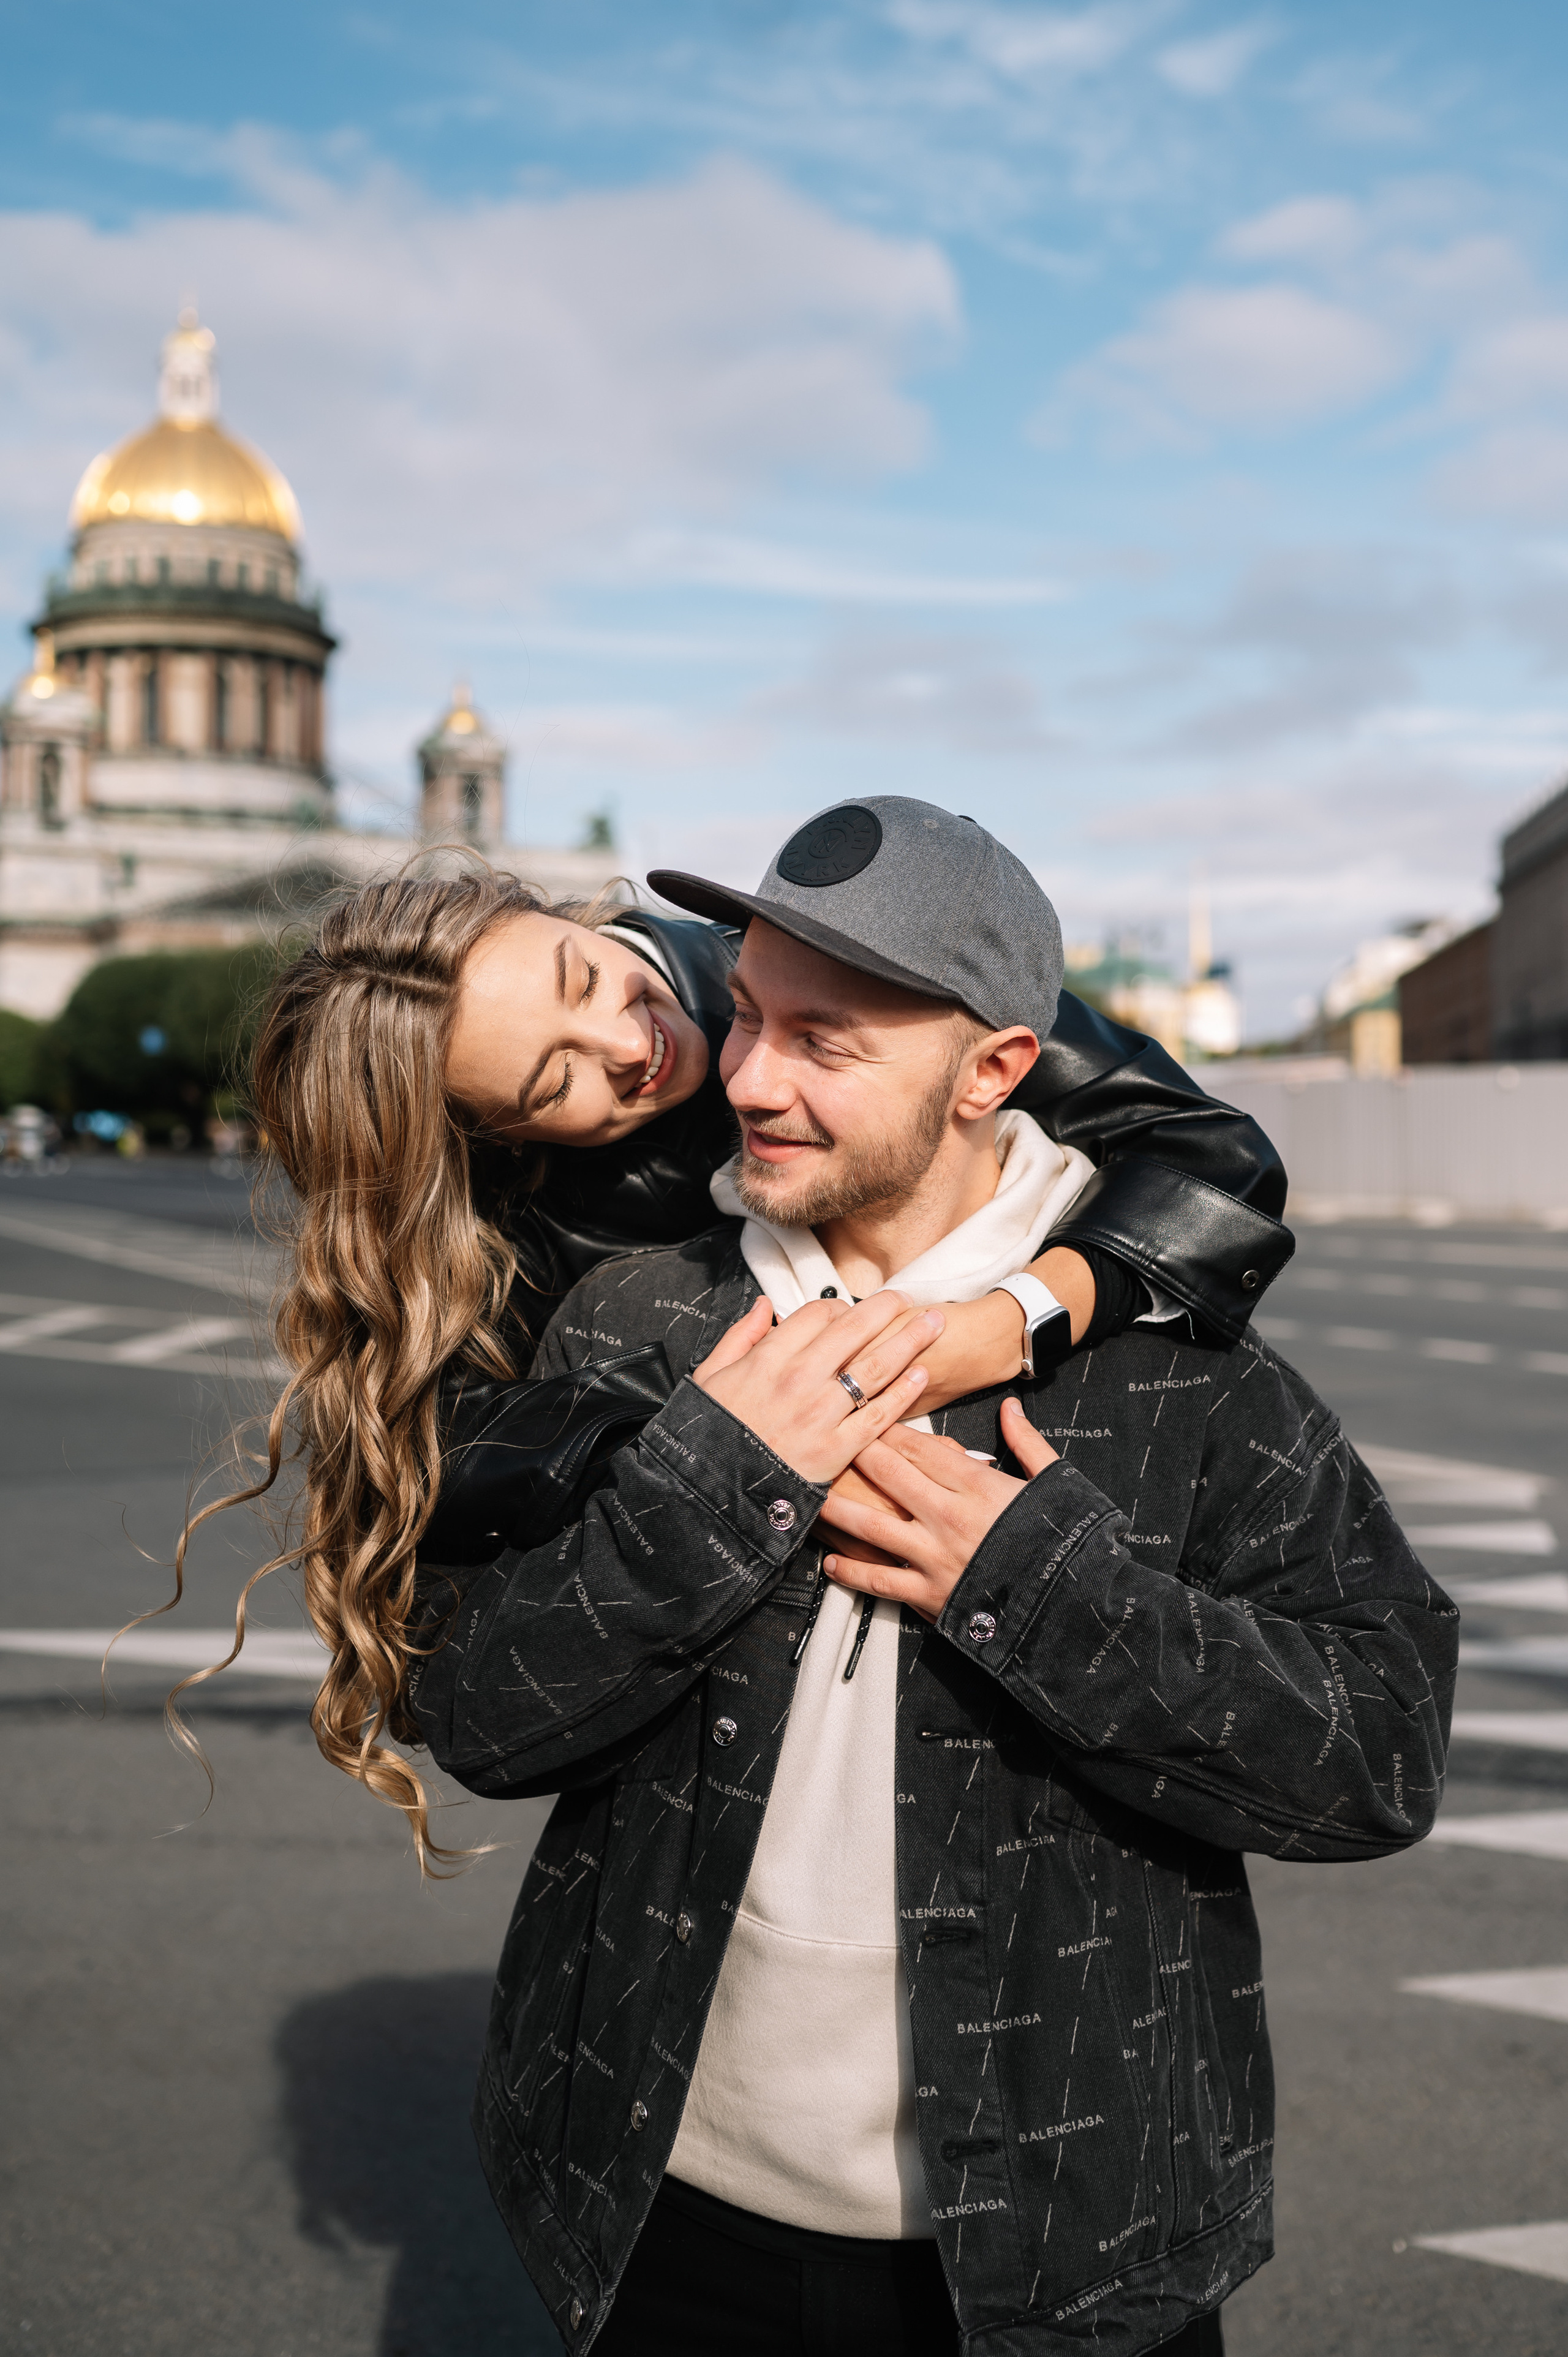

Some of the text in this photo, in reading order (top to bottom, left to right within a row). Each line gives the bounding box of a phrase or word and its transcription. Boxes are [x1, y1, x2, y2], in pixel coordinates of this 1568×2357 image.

[1128, 1375, 1212, 1392] BALENCIAGA
[1039, 1511, 1099, 1580] BALENCIAGA
[1086, 1597, 1136, 1674] BALENCIAGA
[509, 1645, 563, 1716] BALENCIAGA
[1313, 1680, 1339, 1767] BALENCIAGA
[896, 1793, 917, 1805] GA
[957, 2012, 1042, 2035] BALENCIAGA
[1018, 2114, 1105, 2144] BALENCIAGA
[1098, 2214, 1158, 2253] BALENCIAGA
[1054, 2277, 1125, 2323] BALENCIAGA
